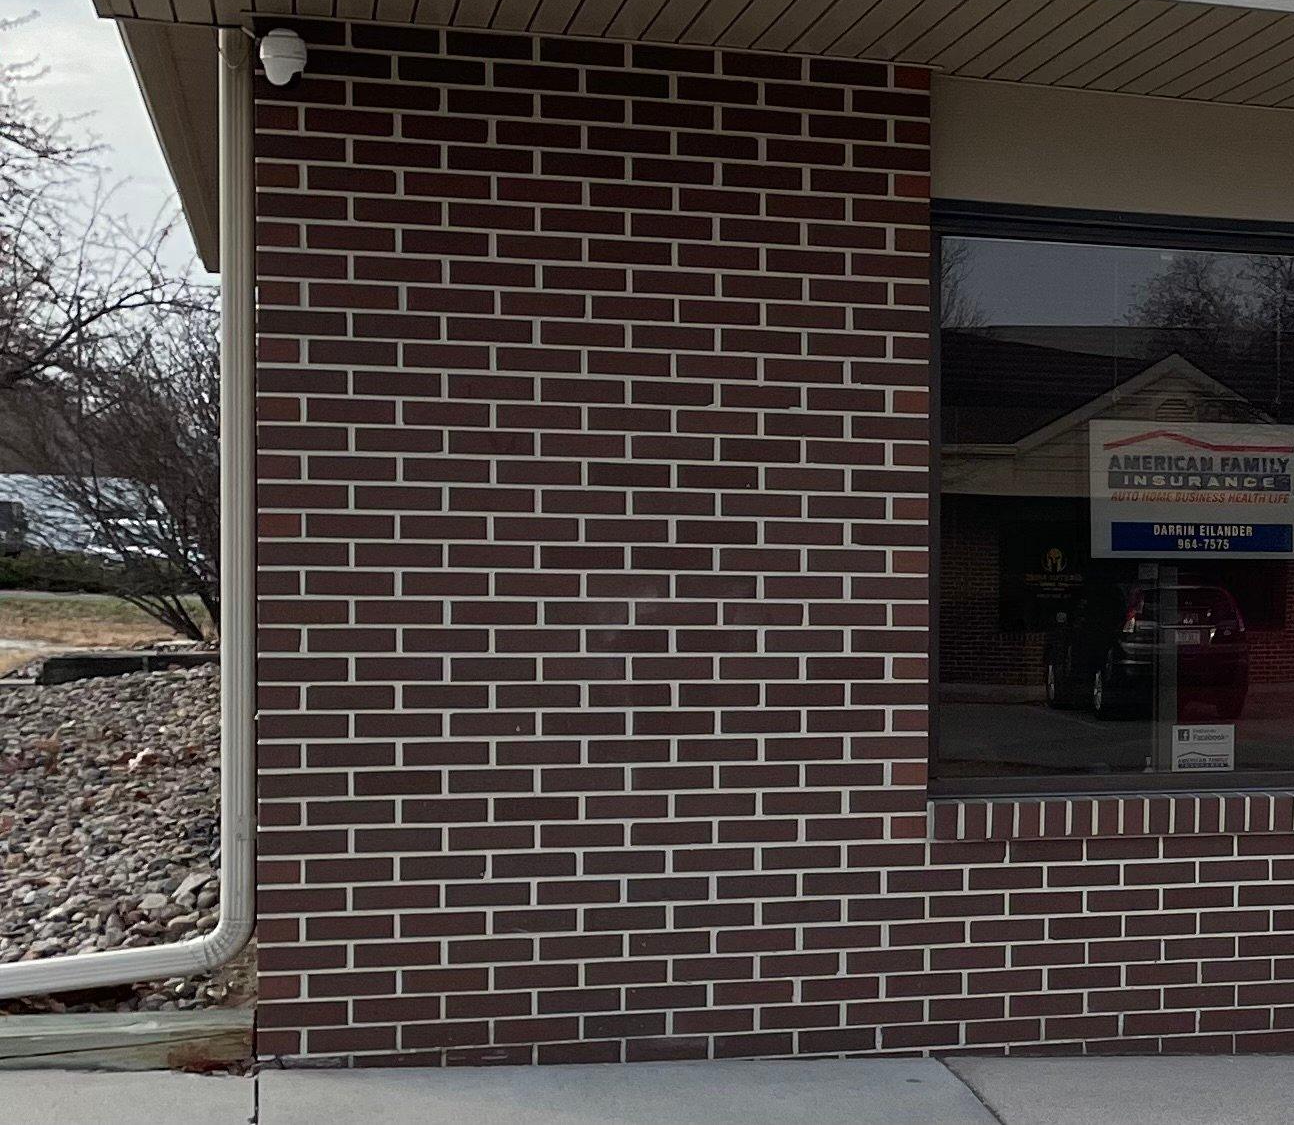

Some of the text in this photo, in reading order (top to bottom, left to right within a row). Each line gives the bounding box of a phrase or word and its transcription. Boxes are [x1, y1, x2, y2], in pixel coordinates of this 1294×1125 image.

[1108, 454, 1290, 473] AMERICAN FAMILY
[1123, 474, 1276, 488] INSURANCE
[1111, 491, 1290, 504] AUTO HOME BUSINESS HEALTH LIFE
[1153, 524, 1253, 537] DARRIN EILANDER
[1177, 538, 1230, 550] 964-7575
